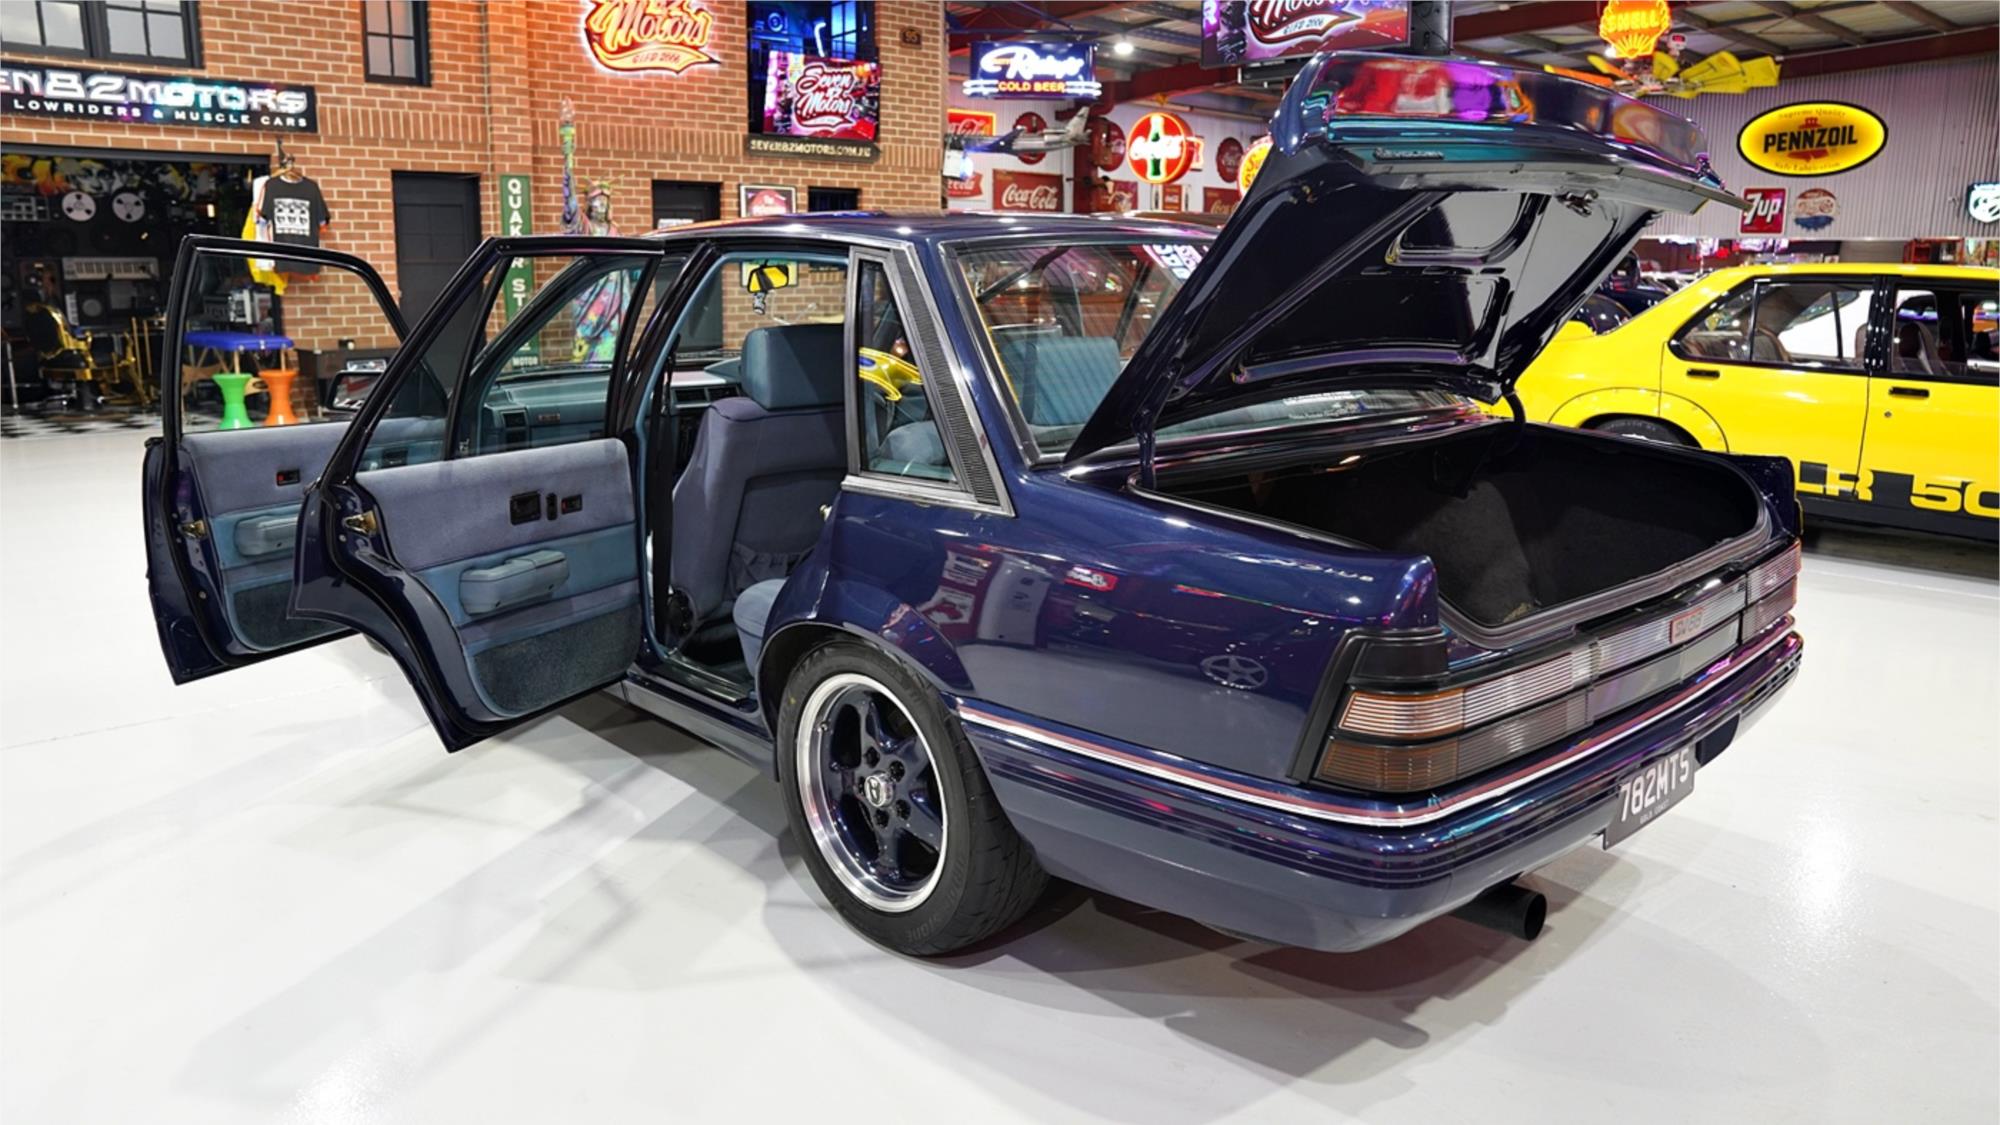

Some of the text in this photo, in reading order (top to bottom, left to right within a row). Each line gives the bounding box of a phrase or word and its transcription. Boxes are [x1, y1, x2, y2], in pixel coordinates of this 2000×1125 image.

[590, 0, 712, 51] Motors
[1606, 9, 1660, 33] SHELL
[796, 64, 852, 94] Seven
[998, 81, 1066, 93] COLD BEER
[13, 99, 307, 127] LOWRIDERS & MUSCLE CARS
[796, 91, 852, 119] Motors
[1763, 125, 1858, 154] PENNZOIL
[1002, 183, 1059, 210] Coca-Cola
[507, 178, 526, 269] QUAKR
